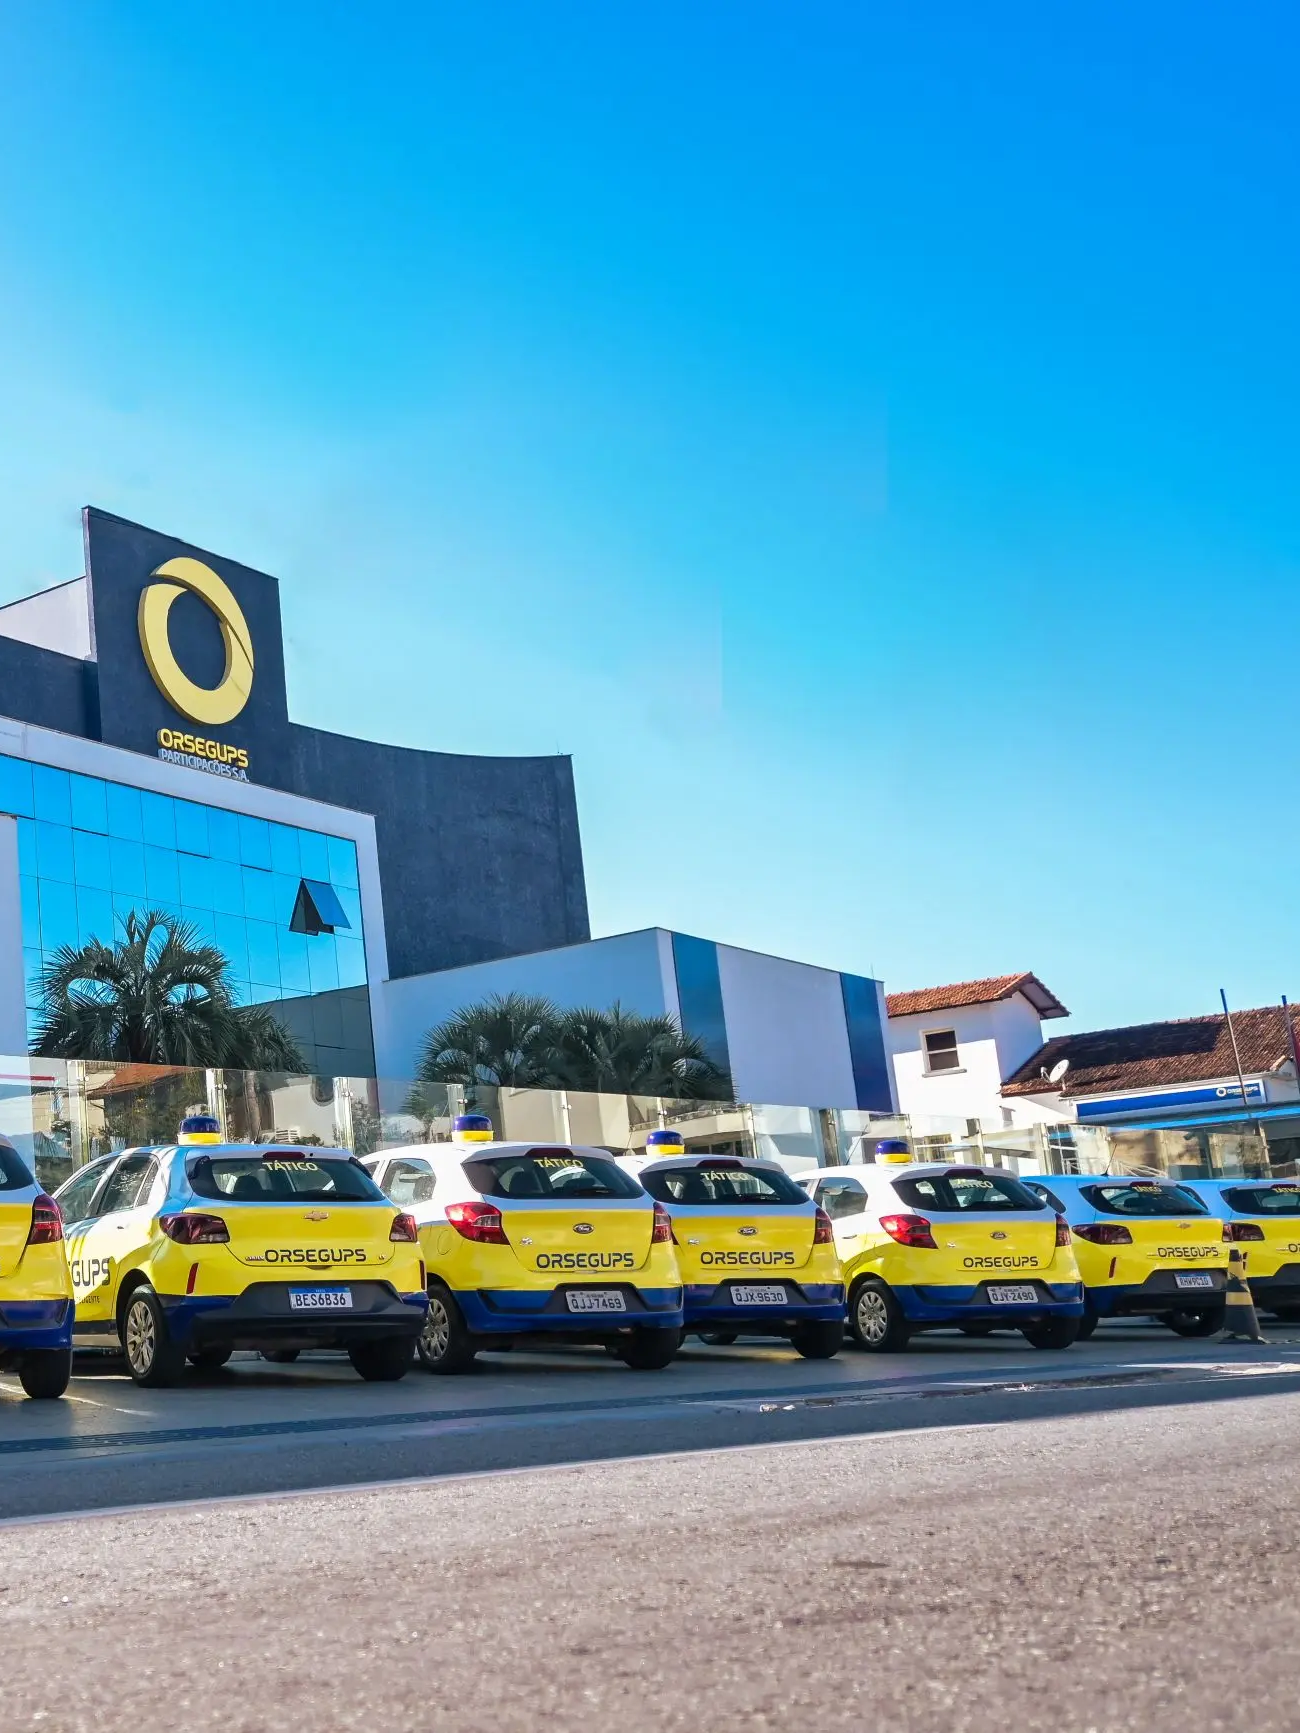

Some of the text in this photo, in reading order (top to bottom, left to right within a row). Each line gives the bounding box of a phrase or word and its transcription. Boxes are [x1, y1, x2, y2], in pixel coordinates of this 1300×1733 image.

[158, 728, 248, 768] ORSEGUPS
[261, 1160, 319, 1171] TÁTICO
[534, 1157, 583, 1168] TÁTICO
[264, 1249, 367, 1262] ORSEGUPS
[700, 1252, 795, 1264] ORSEGUPS
[1157, 1247, 1219, 1257] ORSEGUPS
[536, 1252, 634, 1268] ORSEGUPS
[963, 1256, 1039, 1268] ORSEGUPS
[68, 1257, 111, 1287] GUPS
[295, 1293, 347, 1308] BES6B36
